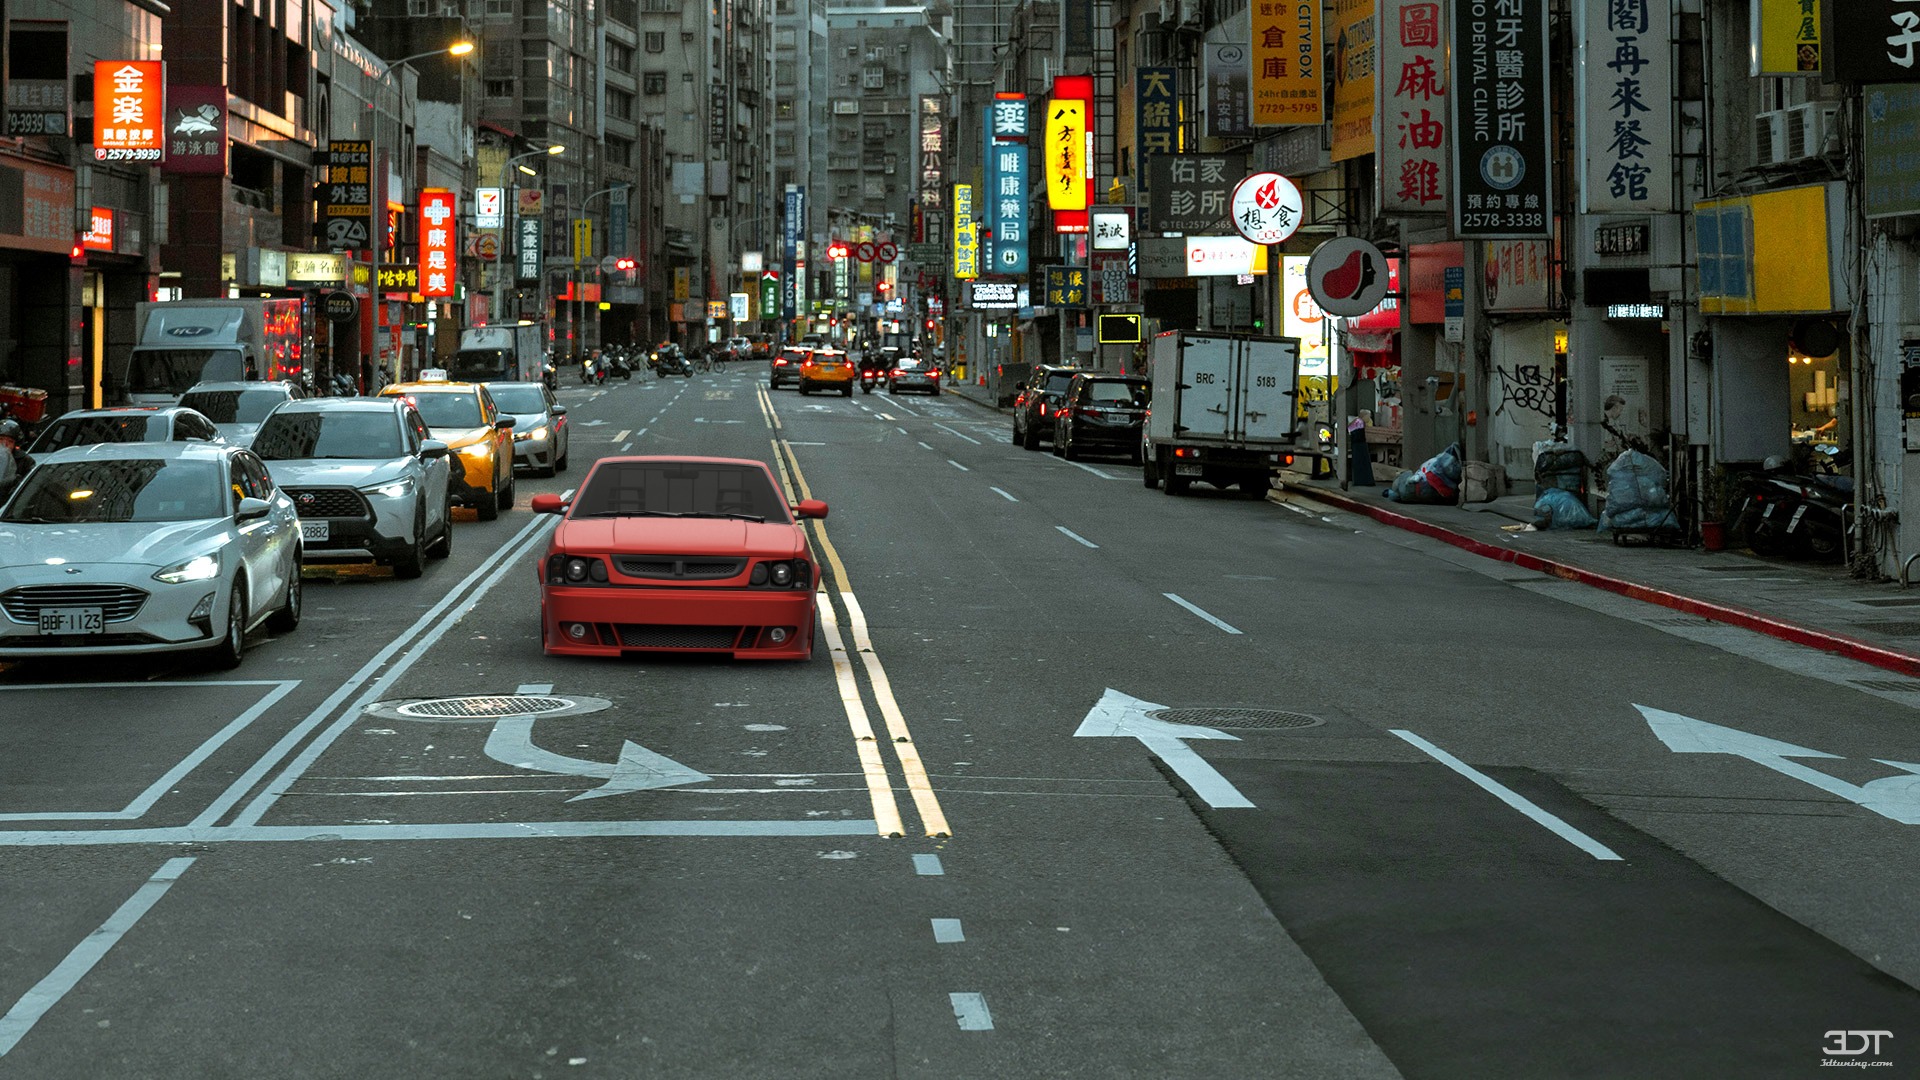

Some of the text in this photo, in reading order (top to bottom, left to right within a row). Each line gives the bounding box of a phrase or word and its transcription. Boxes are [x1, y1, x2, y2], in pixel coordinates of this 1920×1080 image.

[1260, 3, 1287, 17] 迷你
[1261, 25, 1288, 80] 倉庫
[1298, 4, 1313, 79] CITYBOX
[1472, 22, 1487, 84] DENTAL
[1142, 71, 1171, 154] 大統牙
[1258, 103, 1318, 113] 7729-5795
[1394, 2, 1446, 207] 圖麻油雞
[1474, 88, 1489, 142] CLINIC
[106, 148, 161, 160] 2579-3939
[172, 141, 219, 156] 游泳館
[330, 143, 369, 153] PIZZA
[330, 153, 369, 164] ROCK
[1170, 157, 1226, 183] 佑家
[331, 185, 368, 203] 外送
[1170, 189, 1226, 216] 診所
[1467, 194, 1539, 210] 預約專線
[1463, 213, 1543, 228] 2578-3338
[427, 228, 448, 292] 康是美
[521, 219, 539, 279] 英豪西服
[786, 272, 794, 308] SONY
[1196, 372, 1276, 388] BRC 5183
[41, 614, 101, 631] BBF-1123
